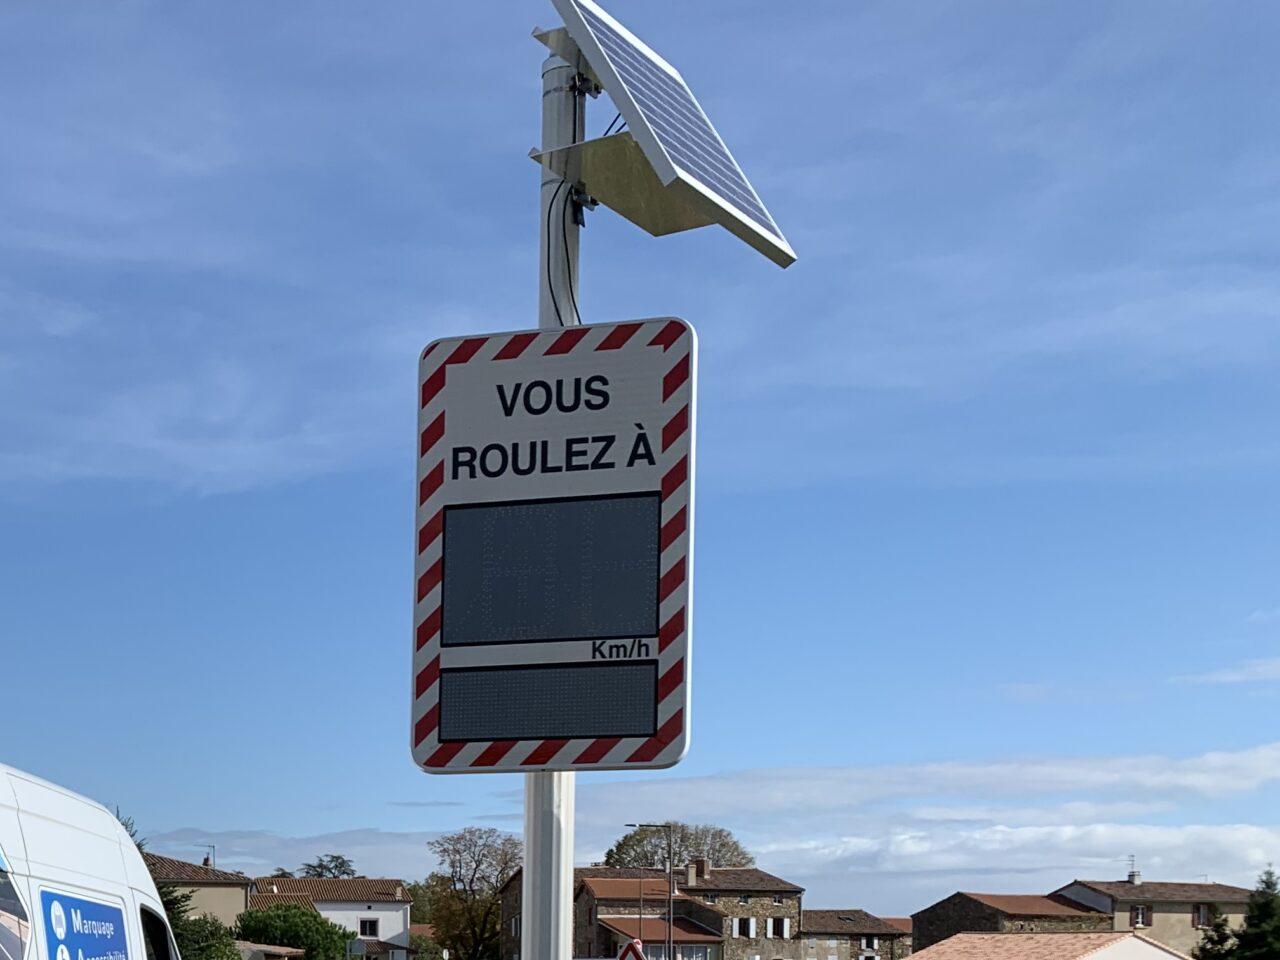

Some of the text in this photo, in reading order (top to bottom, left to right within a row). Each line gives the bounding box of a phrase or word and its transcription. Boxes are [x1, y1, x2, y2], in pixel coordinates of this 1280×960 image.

[496, 375, 610, 417] VOUS
[451, 423, 657, 480] ROULEZ À
[591, 638, 650, 659] Km/h
[71, 908, 115, 939] Marquage
